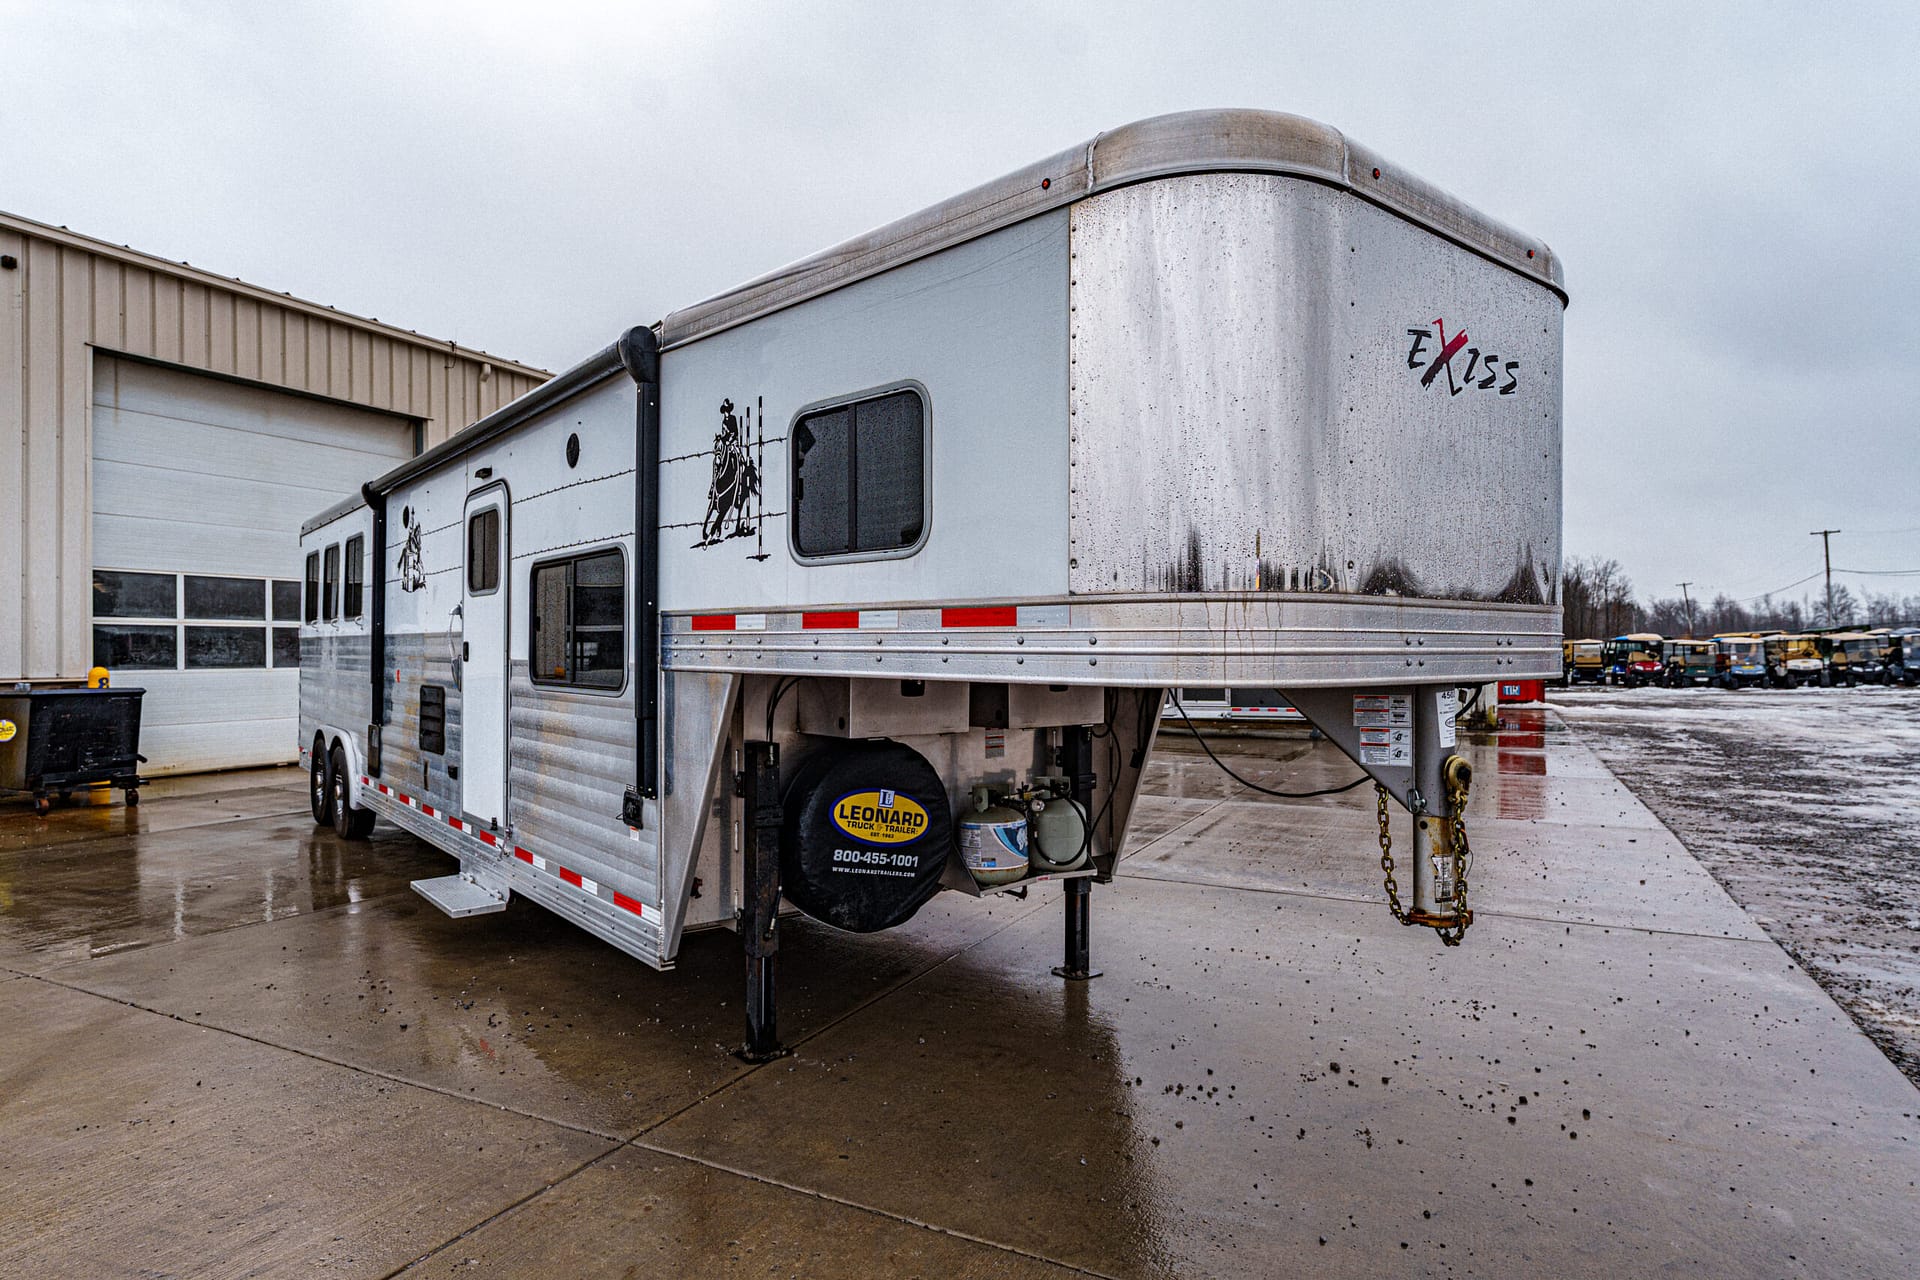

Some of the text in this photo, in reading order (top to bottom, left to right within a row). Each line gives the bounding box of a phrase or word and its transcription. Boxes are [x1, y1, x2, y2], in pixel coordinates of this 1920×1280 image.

[839, 804, 924, 827] LEONARD
[846, 820, 875, 831] TRUCK
[885, 825, 916, 835] TRAILER
[833, 849, 919, 868] 800-455-1001
